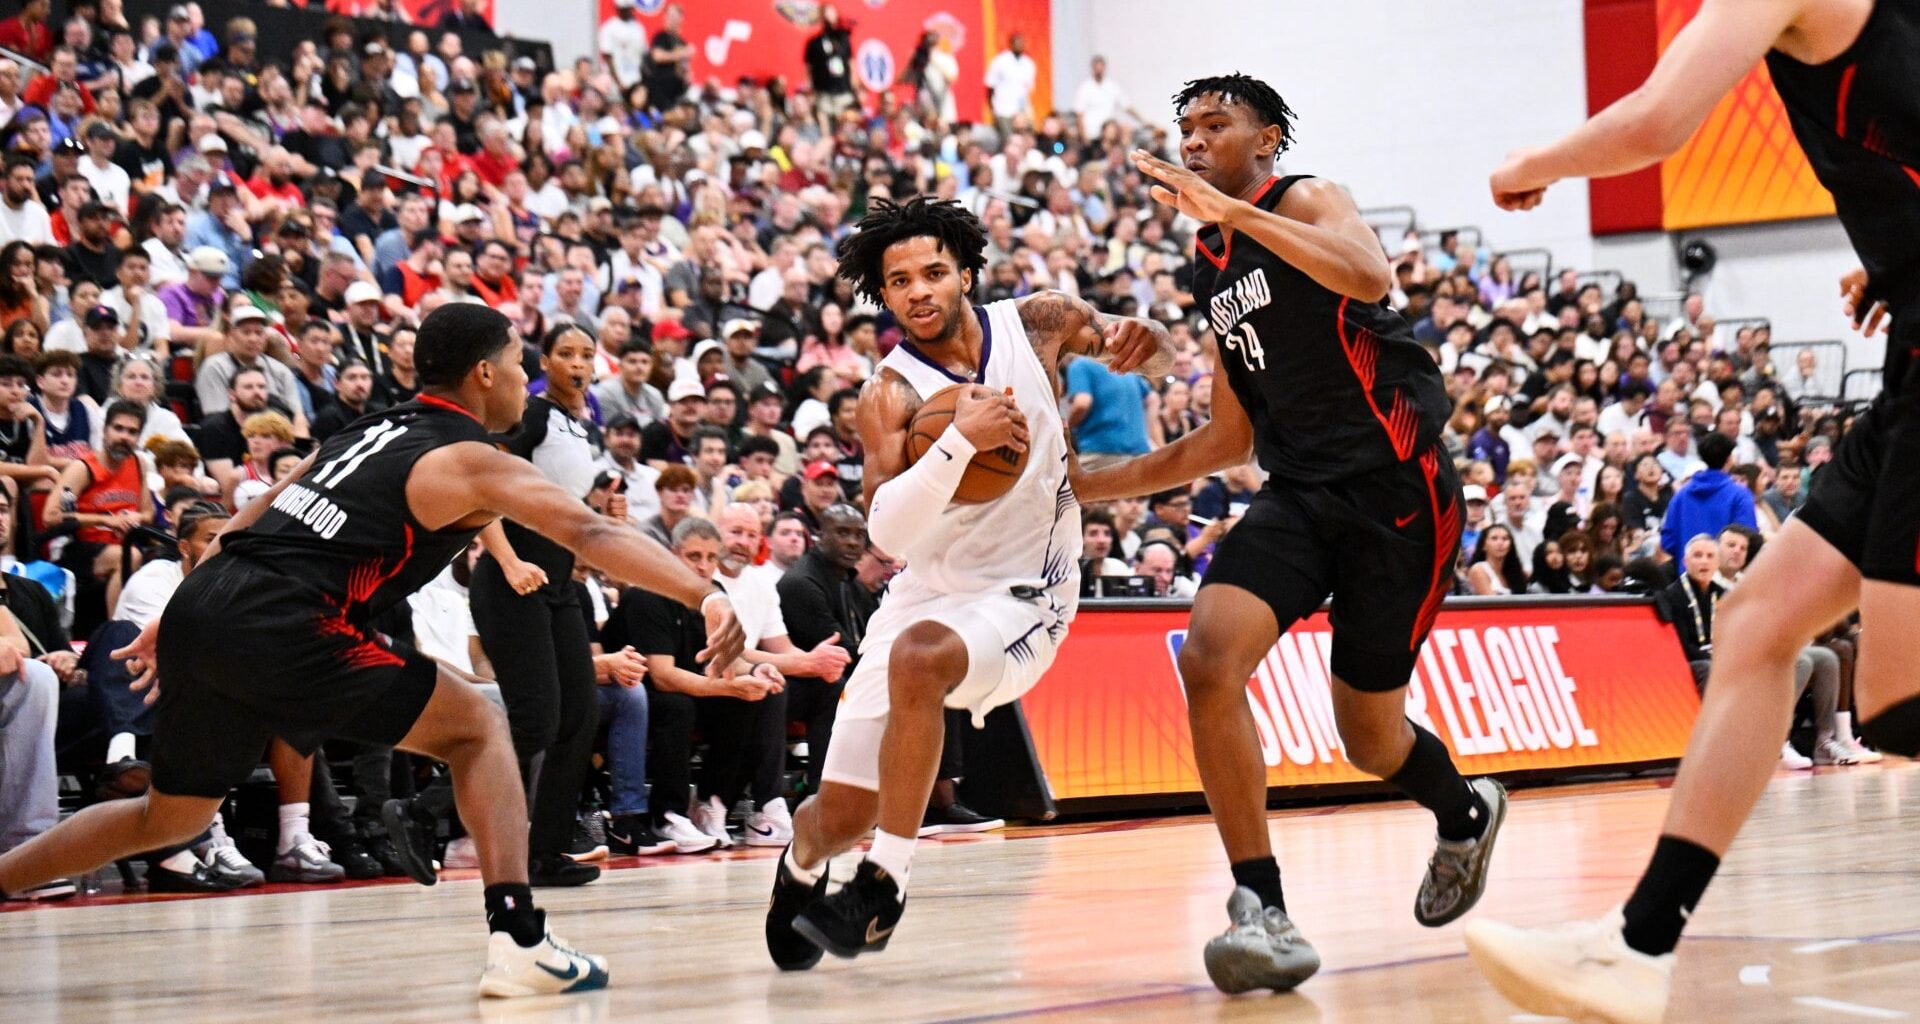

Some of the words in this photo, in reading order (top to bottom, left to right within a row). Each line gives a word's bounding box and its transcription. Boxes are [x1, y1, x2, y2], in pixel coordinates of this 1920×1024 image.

[311, 418, 409, 490] 11
[269, 482, 348, 540] UNGBLOOD
[1420, 625, 1599, 757] LEAGUE
